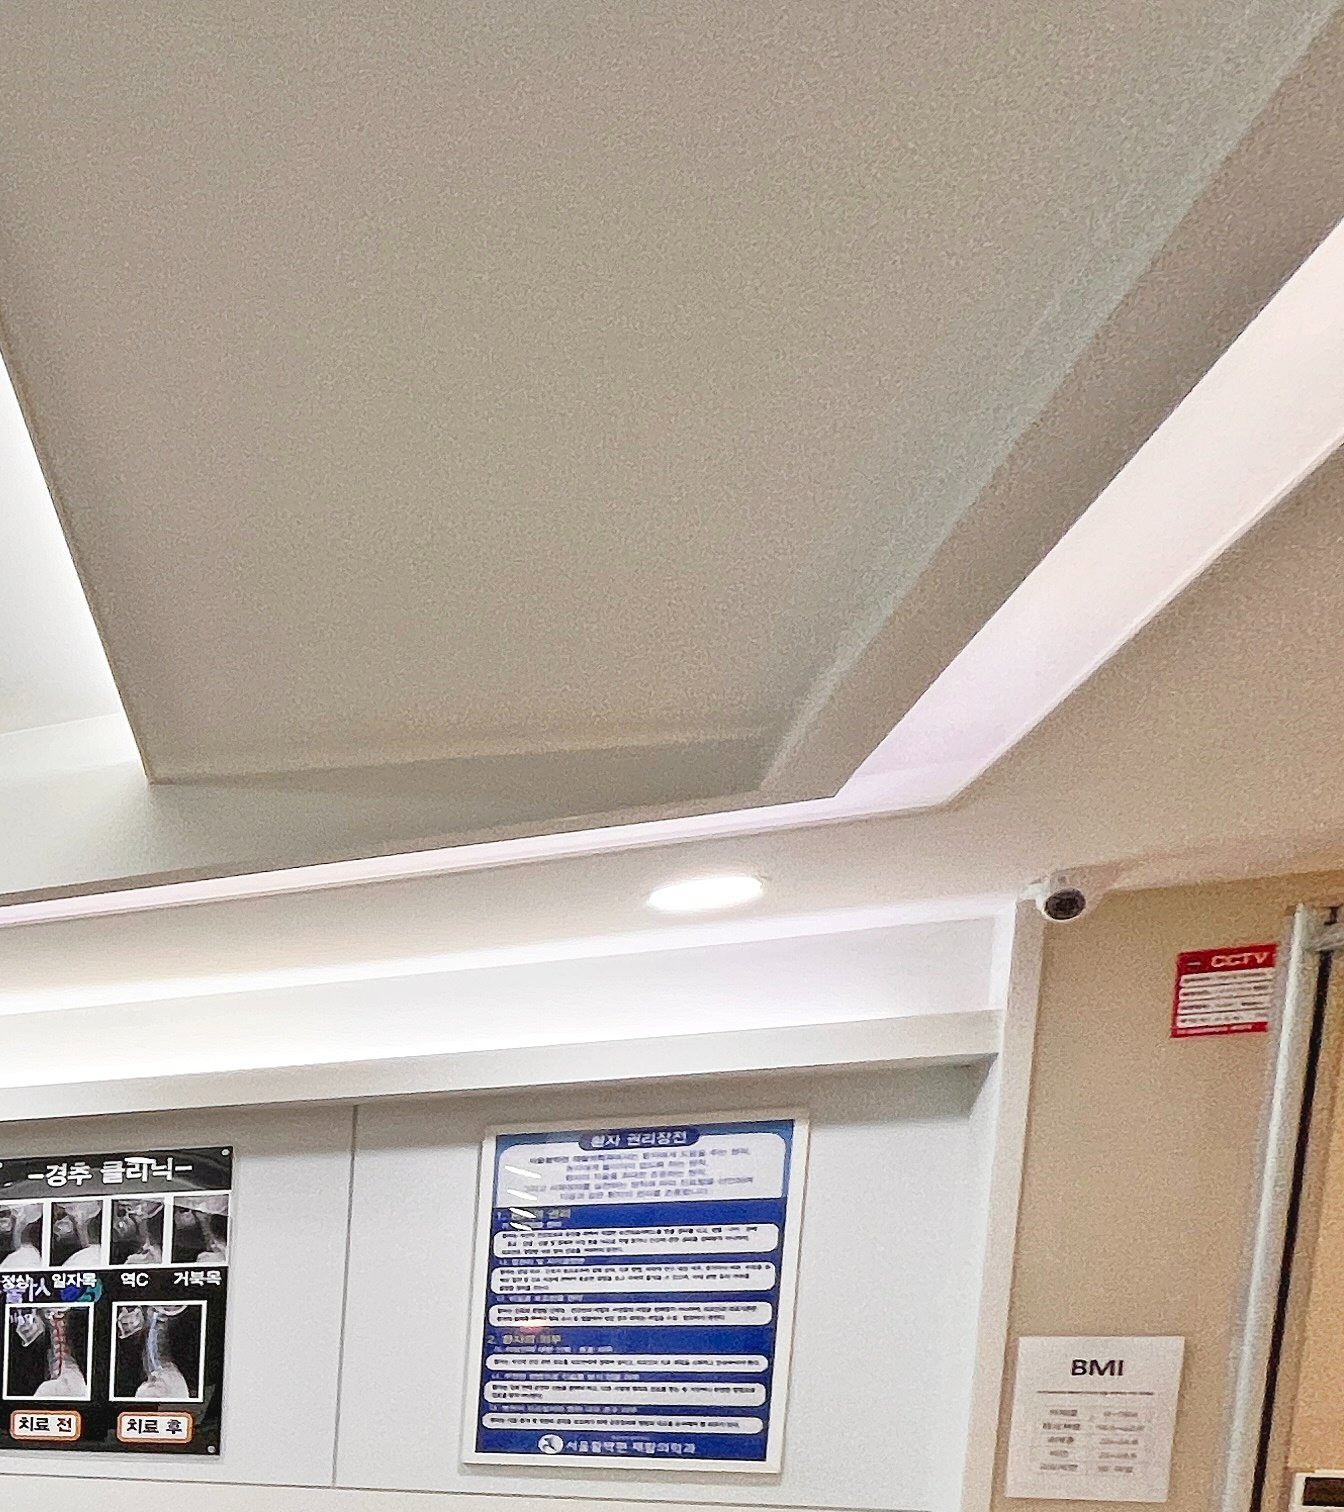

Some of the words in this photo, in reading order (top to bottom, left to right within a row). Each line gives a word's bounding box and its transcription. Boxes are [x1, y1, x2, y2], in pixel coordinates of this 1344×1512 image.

[1212, 952, 1269, 967] CCTV
[173, 1271, 222, 1286] 거북목
[1071, 1359, 1124, 1376] BMI
[19, 1417, 49, 1431] 치료
[57, 1418, 72, 1433] 전
[127, 1419, 159, 1433] 치료
[166, 1419, 182, 1434] 후
